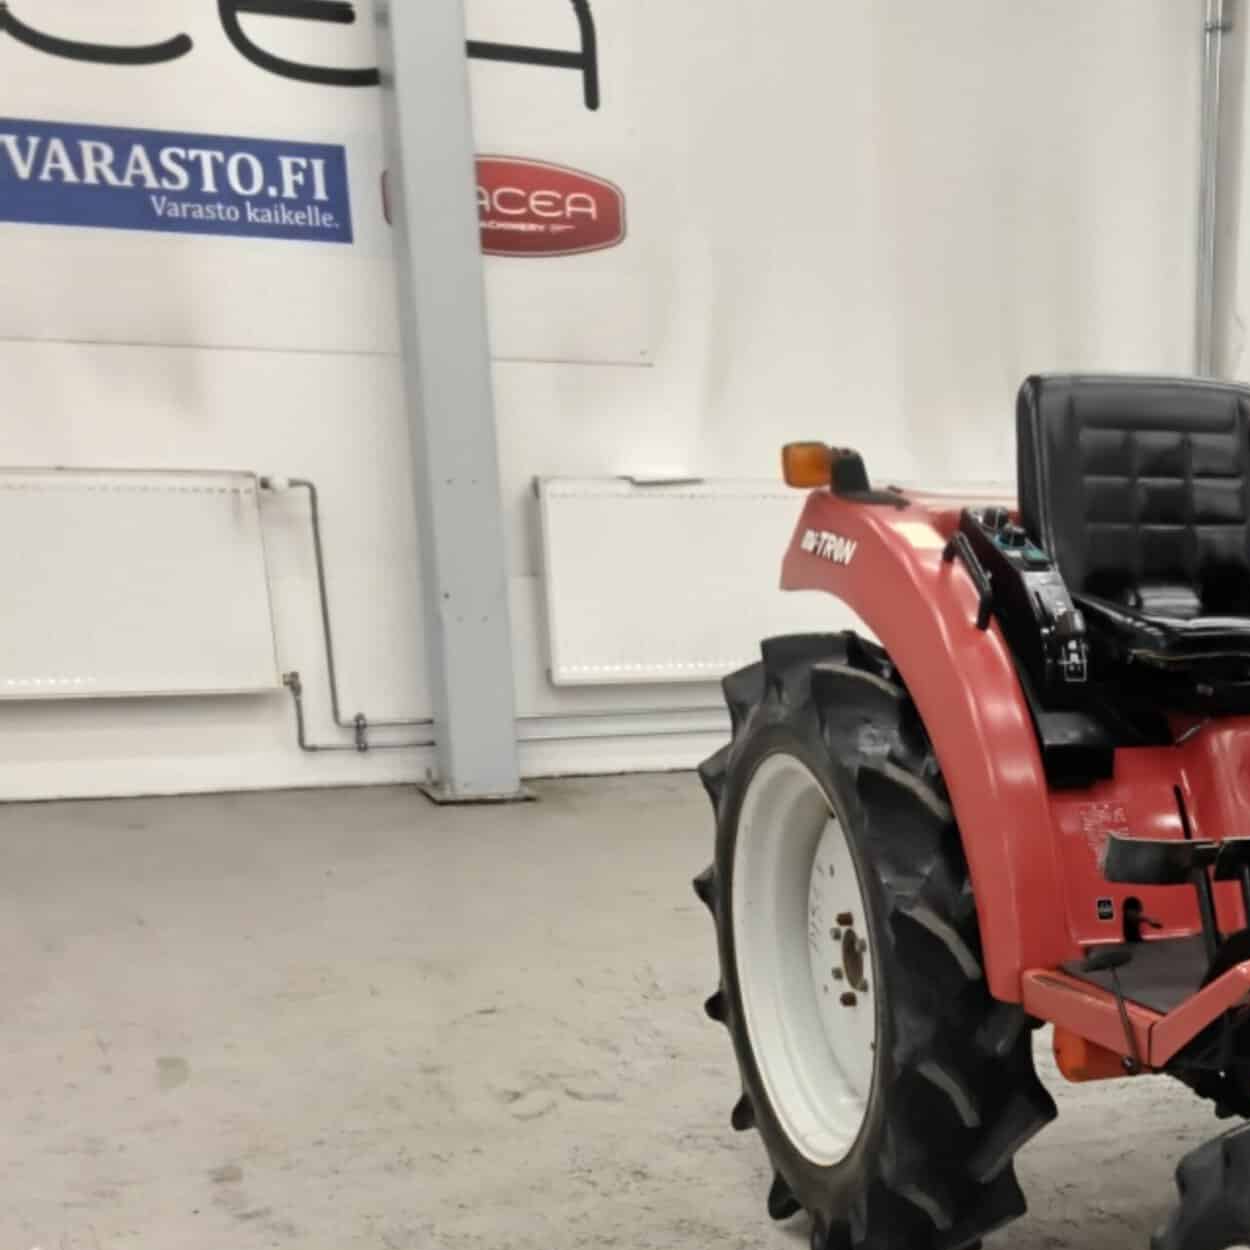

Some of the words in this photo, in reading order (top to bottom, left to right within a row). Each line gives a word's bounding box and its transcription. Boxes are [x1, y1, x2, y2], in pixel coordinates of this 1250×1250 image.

[0, 134, 329, 201] VARASTO.FI
[151, 195, 240, 222] Varasto
[247, 201, 340, 229] kaikelle.
